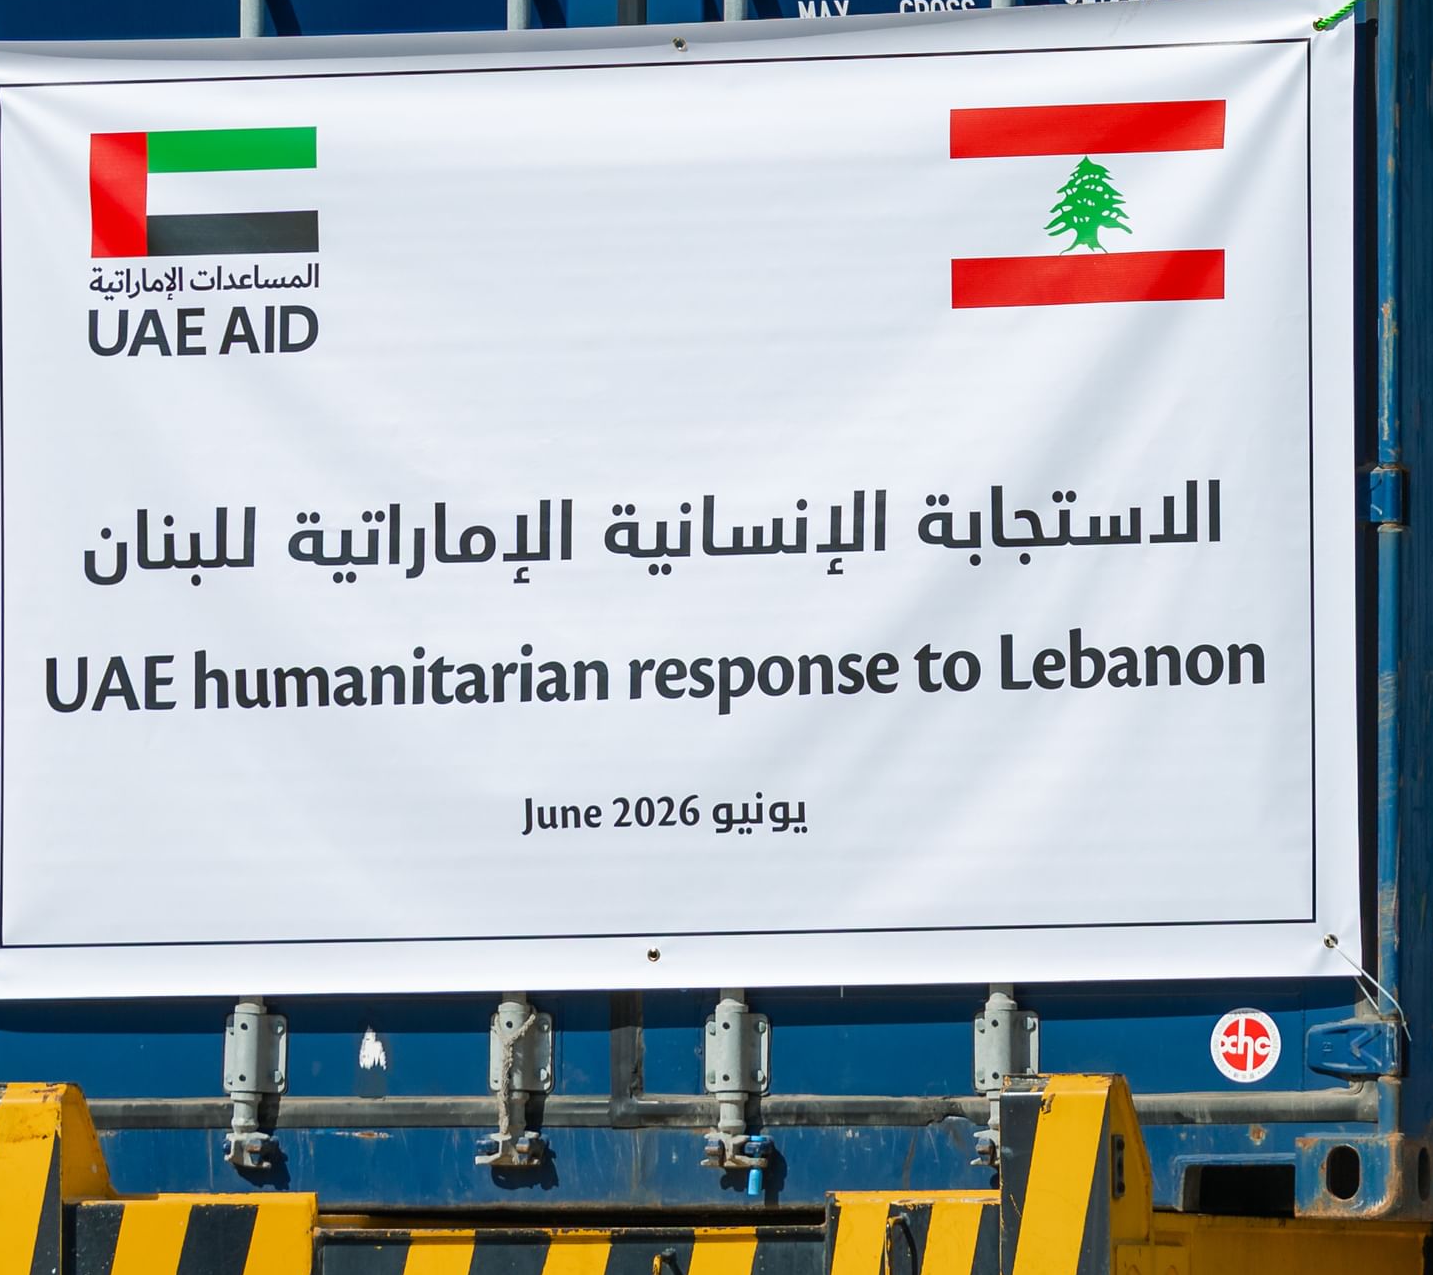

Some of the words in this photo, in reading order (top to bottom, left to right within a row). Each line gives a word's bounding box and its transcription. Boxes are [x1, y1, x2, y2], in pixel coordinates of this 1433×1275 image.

[89, 266, 184, 301] الإماراتية
[190, 262, 320, 292] المساعدات
[88, 307, 207, 357] UAE
[218, 304, 319, 355] AID
[84, 506, 256, 587] للبنان
[287, 498, 573, 584] الإماراتية
[604, 489, 887, 576] الإنسانية
[917, 479, 1221, 567] الاستجابة
[45, 654, 177, 714] UAE
[194, 643, 609, 710] humanitarian
[628, 652, 900, 716] response
[913, 643, 982, 693] to
[1000, 627, 1265, 691] Lebanon
[521, 797, 602, 836] June
[612, 794, 700, 828] 2026
[712, 791, 808, 835] يونيو
